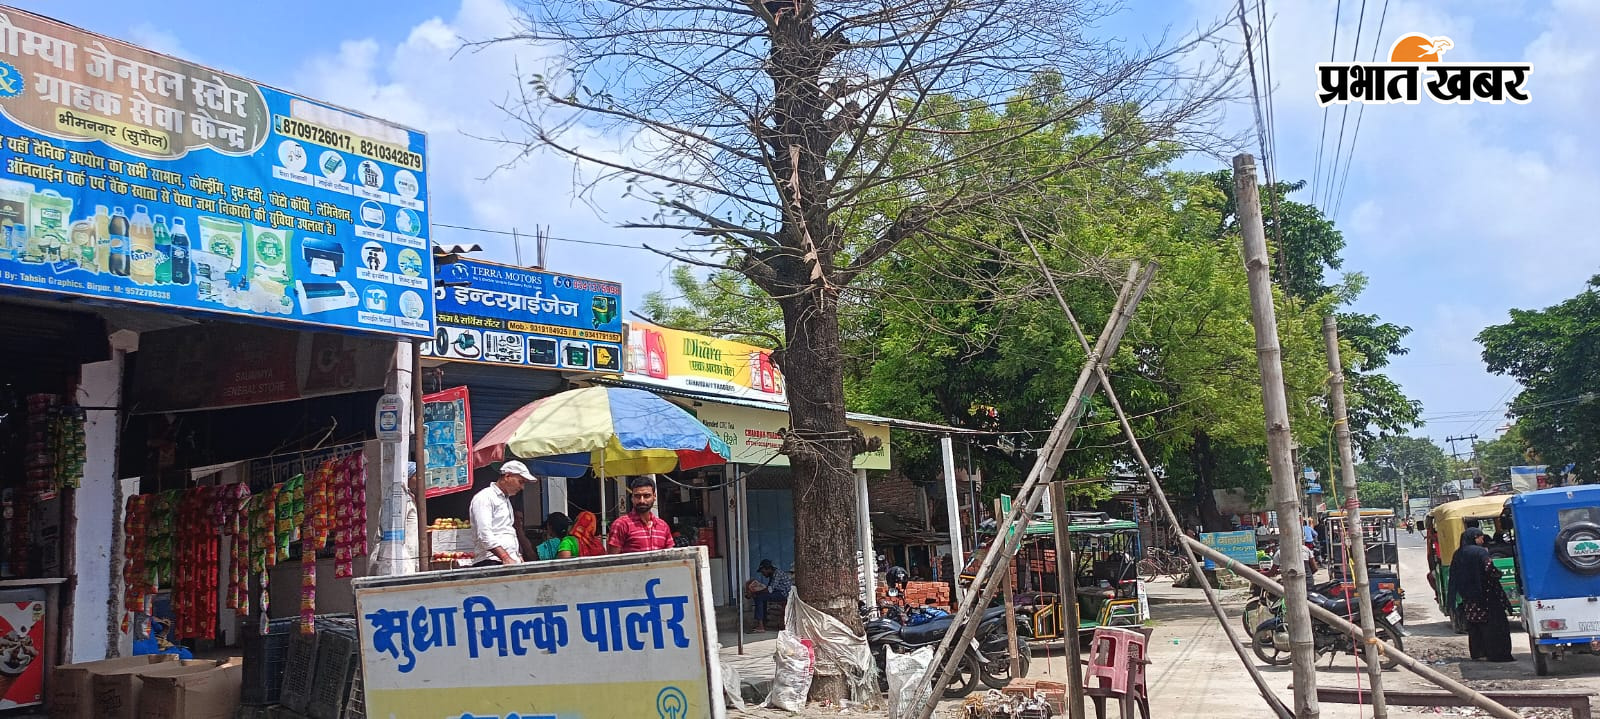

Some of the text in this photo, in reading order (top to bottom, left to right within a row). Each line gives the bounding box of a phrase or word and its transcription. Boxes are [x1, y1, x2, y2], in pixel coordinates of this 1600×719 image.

[33, 72, 247, 149] ग्राहक सेवा केन्द्र
[84, 40, 186, 101] जेनरल
[191, 75, 249, 118] स्टोर
[58, 111, 168, 151] भीमनगर (सुपौल)
[360, 140, 421, 169] 8210342879
[7, 157, 64, 182] ऑनलाईन
[66, 170, 86, 187] वर्क
[89, 175, 106, 191] एवं
[109, 175, 128, 194] बैंक
[161, 187, 170, 204] से
[173, 189, 192, 208] पैसा
[195, 197, 216, 212] जमा
[218, 199, 251, 219] निकासी
[254, 205, 266, 222] की
[32, 139, 66, 162] दैनिक
[69, 151, 105, 170] उपयोग
[108, 158, 123, 173] का
[127, 161, 148, 179] सभी
[268, 191, 288, 208] फोटो
[471, 266, 542, 285] TERRA MOTORS
[365, 578, 690, 673] सुधा मिल्क पार्लर
